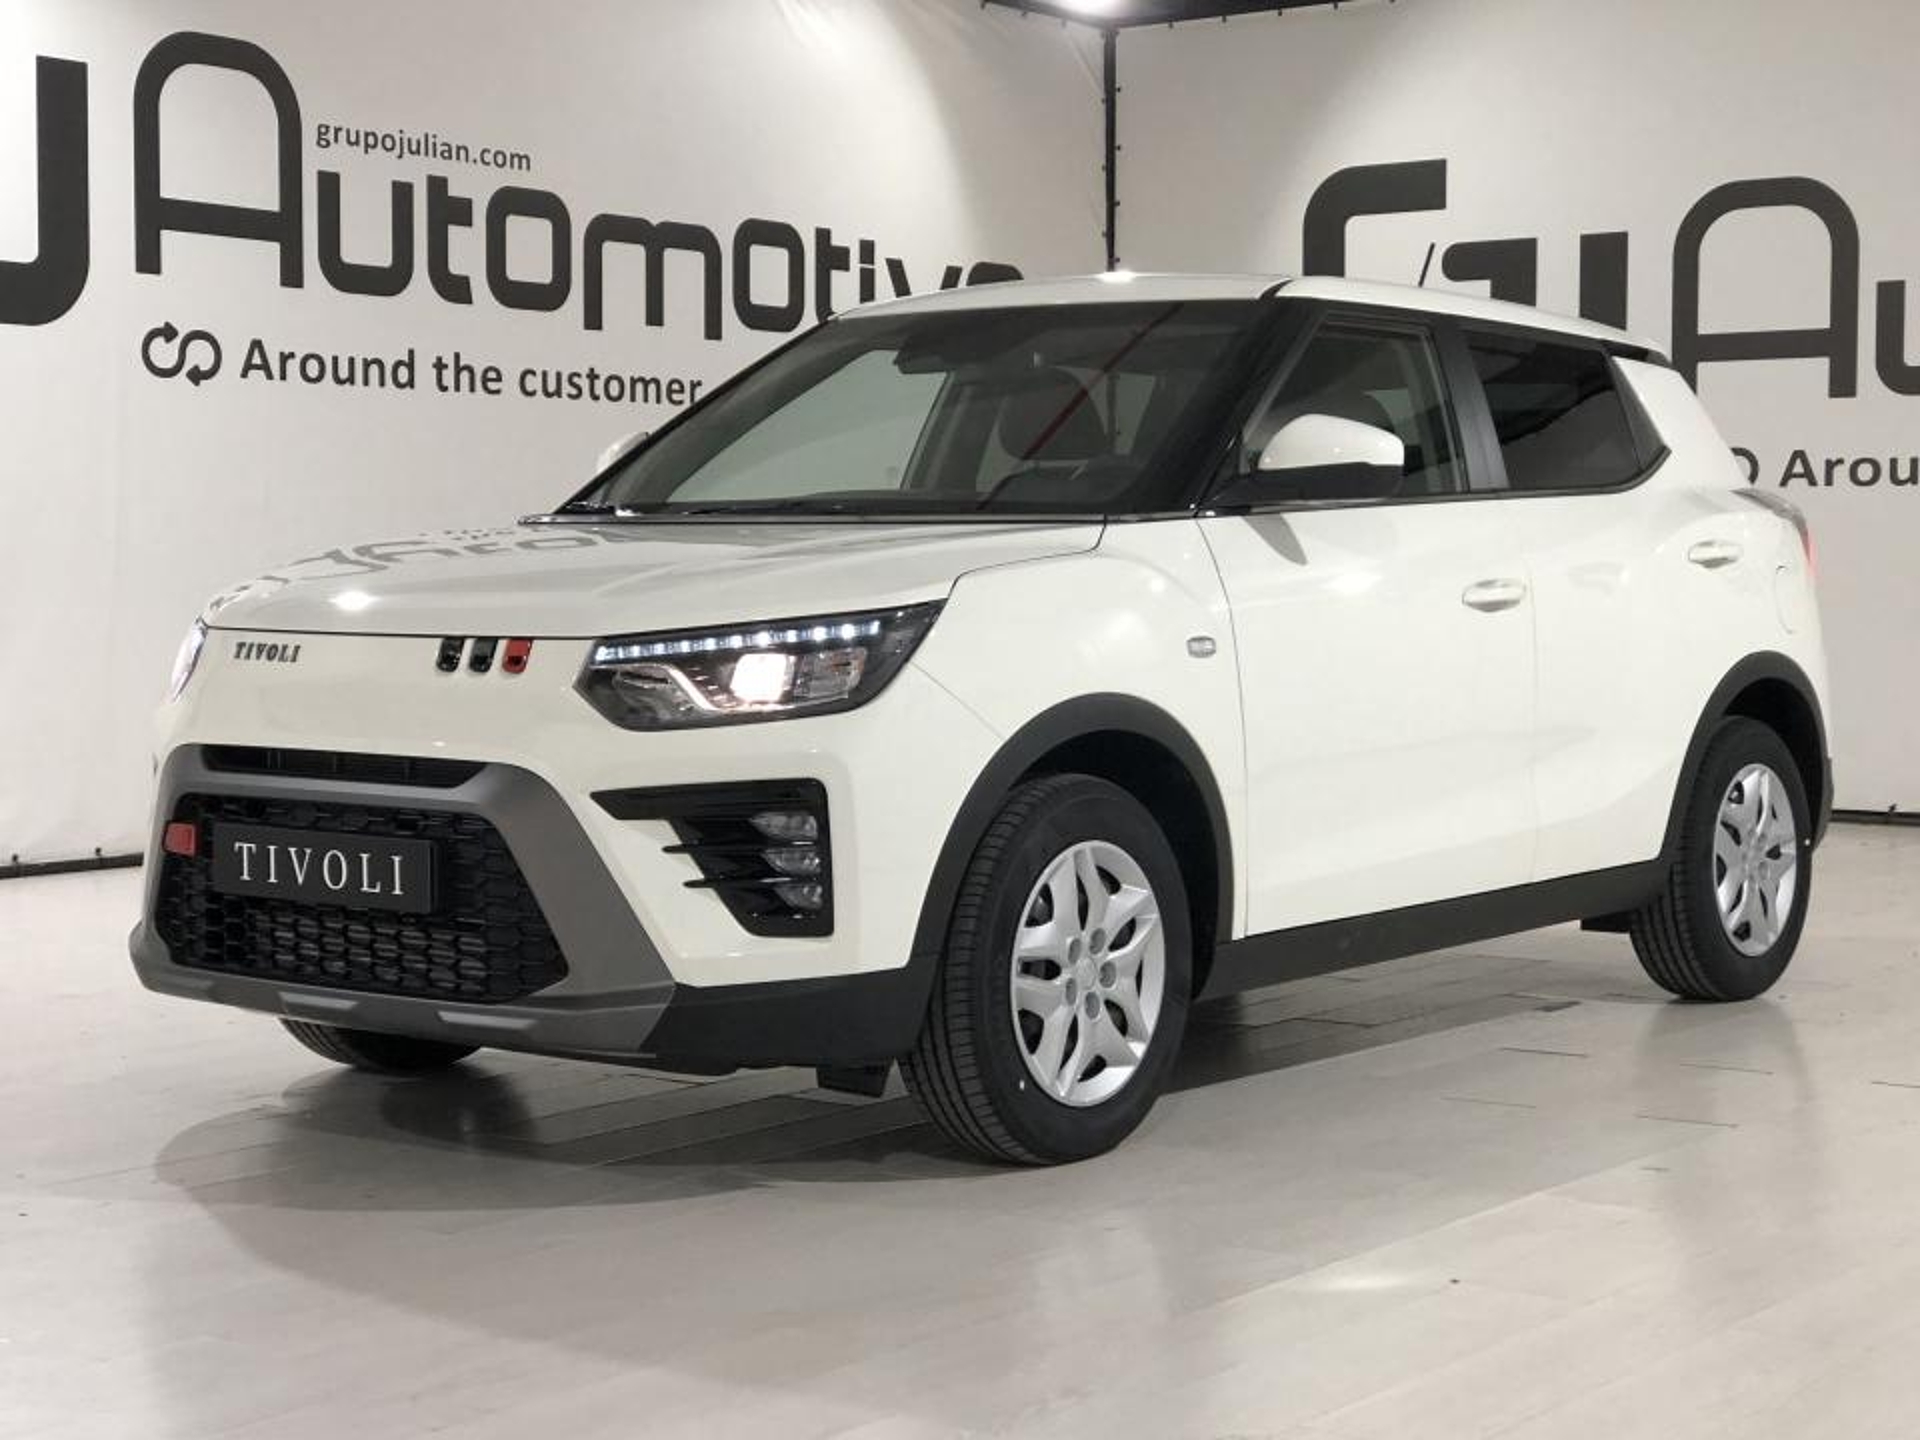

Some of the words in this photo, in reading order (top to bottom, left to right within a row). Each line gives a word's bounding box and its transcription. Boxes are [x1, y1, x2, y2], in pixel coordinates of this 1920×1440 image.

[315, 123, 531, 171] grupojulian.com
[133, 31, 1026, 341] Automoti
[240, 339, 415, 390] Around
[432, 352, 503, 396] the
[518, 367, 703, 410] customer
[233, 641, 301, 663] TIVOLI
[234, 841, 404, 895] TIVOLI
